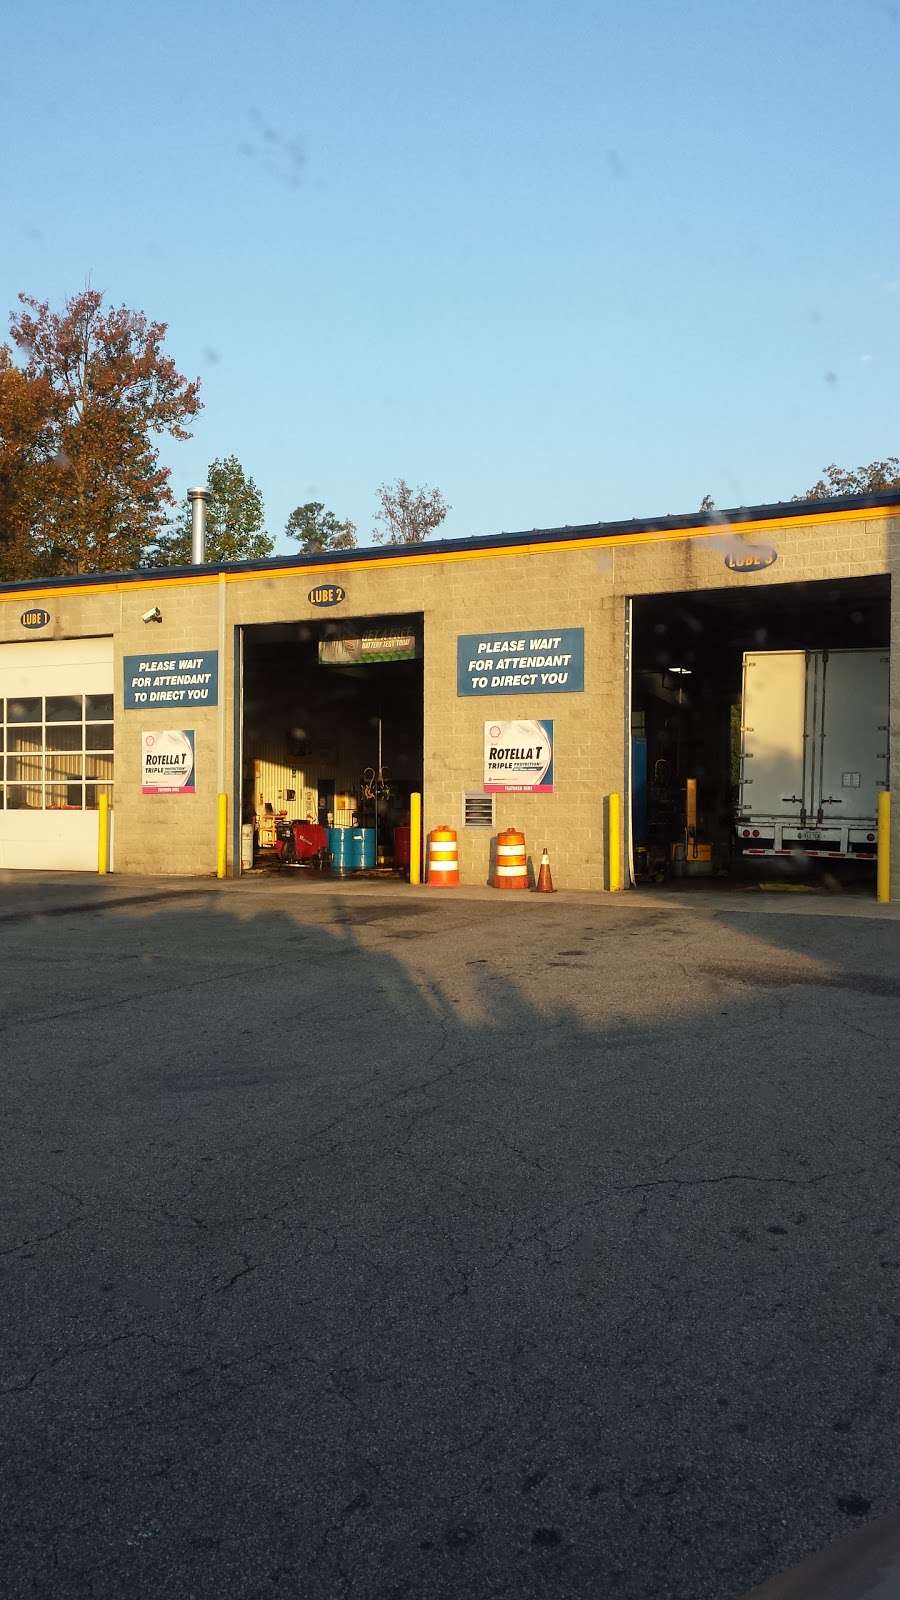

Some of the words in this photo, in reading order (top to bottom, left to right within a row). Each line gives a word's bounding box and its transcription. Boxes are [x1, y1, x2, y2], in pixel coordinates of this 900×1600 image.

[310, 590, 333, 603] LUBE
[336, 589, 342, 601] 2
[23, 613, 41, 624] LUBE
[44, 612, 48, 624] 1
[477, 640, 526, 653] PLEASE
[529, 637, 562, 650] WAIT
[138, 660, 177, 673] PLEASE
[178, 658, 204, 670] WAIT
[468, 660, 494, 672] FOR
[495, 655, 571, 670] ATTENDANT
[132, 677, 152, 688] FOR
[153, 674, 211, 686] ATTENDANT
[471, 676, 489, 689] TO
[490, 673, 539, 687] DIRECT
[540, 672, 569, 685] YOU
[134, 692, 148, 703] TO
[149, 690, 186, 702] DIRECT
[187, 688, 209, 700] YOU
[146, 754, 180, 765] ROTELLA
[181, 753, 187, 765] T
[489, 747, 533, 760] ROTELLA
[535, 746, 543, 760] T
